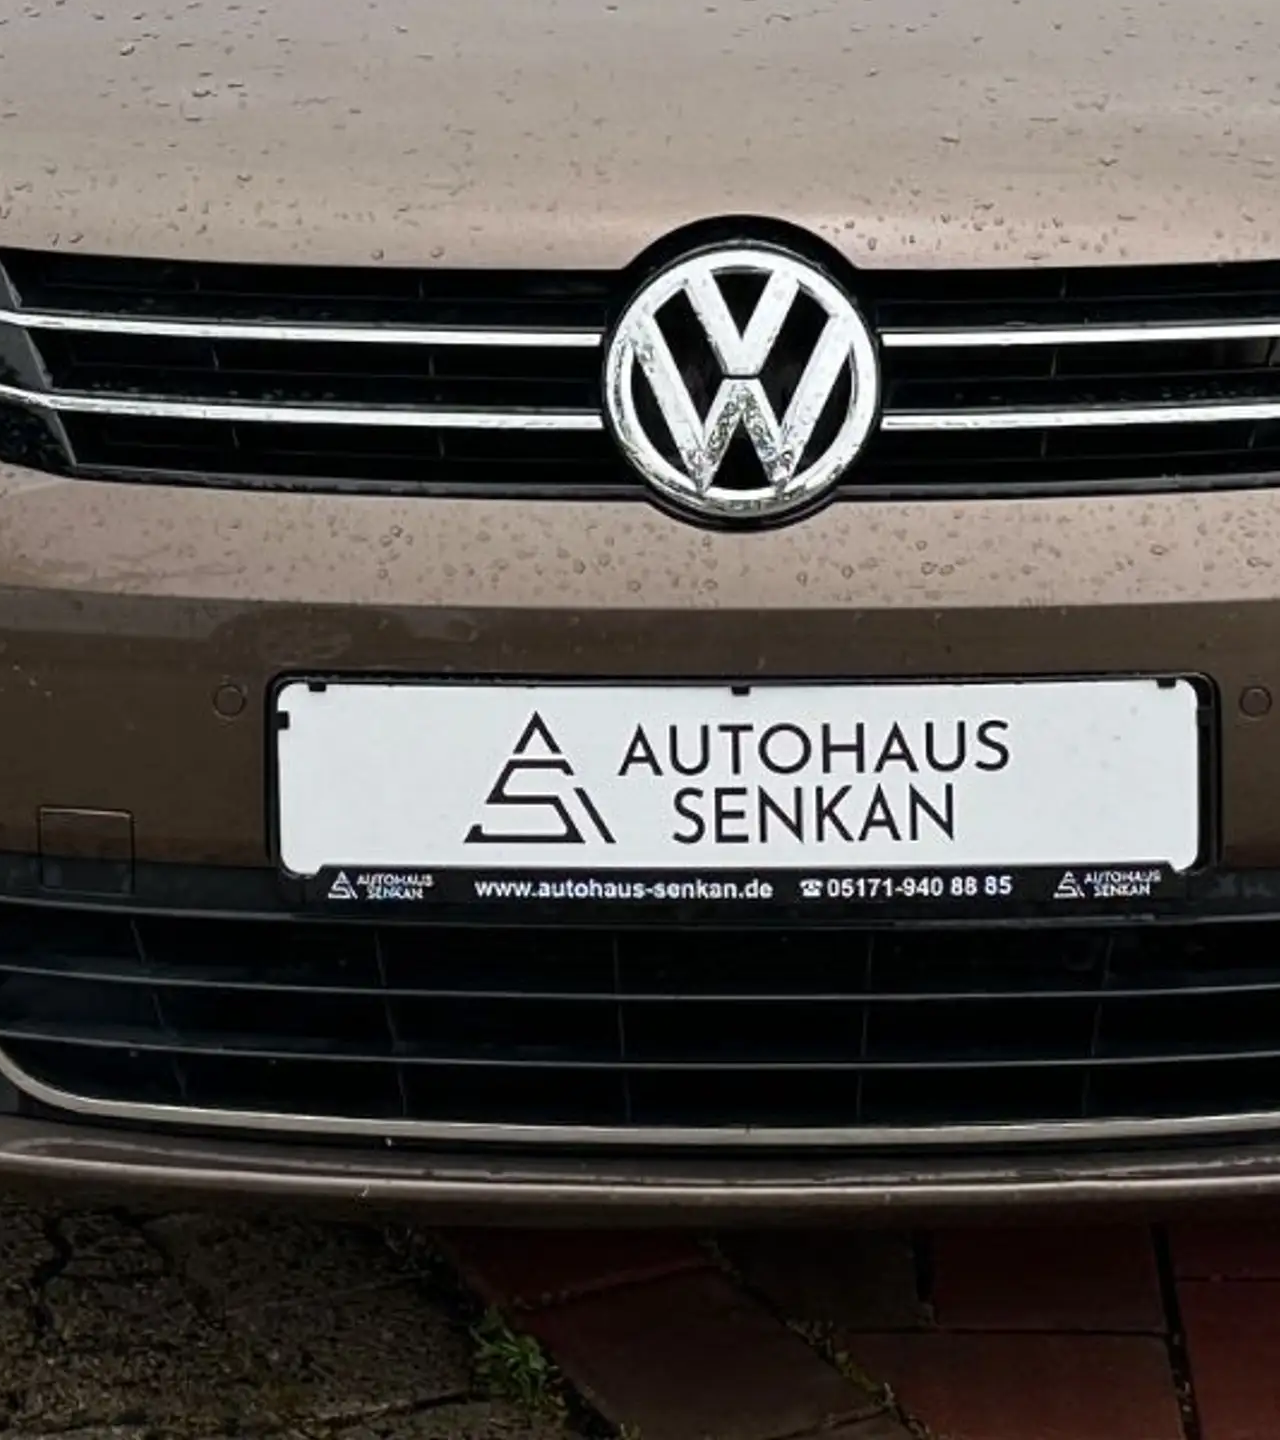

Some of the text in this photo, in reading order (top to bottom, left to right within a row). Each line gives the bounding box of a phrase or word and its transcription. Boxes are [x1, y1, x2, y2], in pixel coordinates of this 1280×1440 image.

[619, 720, 1010, 777] AUTOHAUS
[672, 783, 955, 844] SENKAN
[356, 873, 434, 887] AUTOHAUS
[827, 875, 1013, 898] 05171-940 88 85
[1085, 870, 1161, 885] AUTOHAUS
[367, 886, 424, 899] SENKAN
[474, 878, 774, 899] www.autohaus-senkan.de
[1093, 883, 1151, 897] SENKAN
